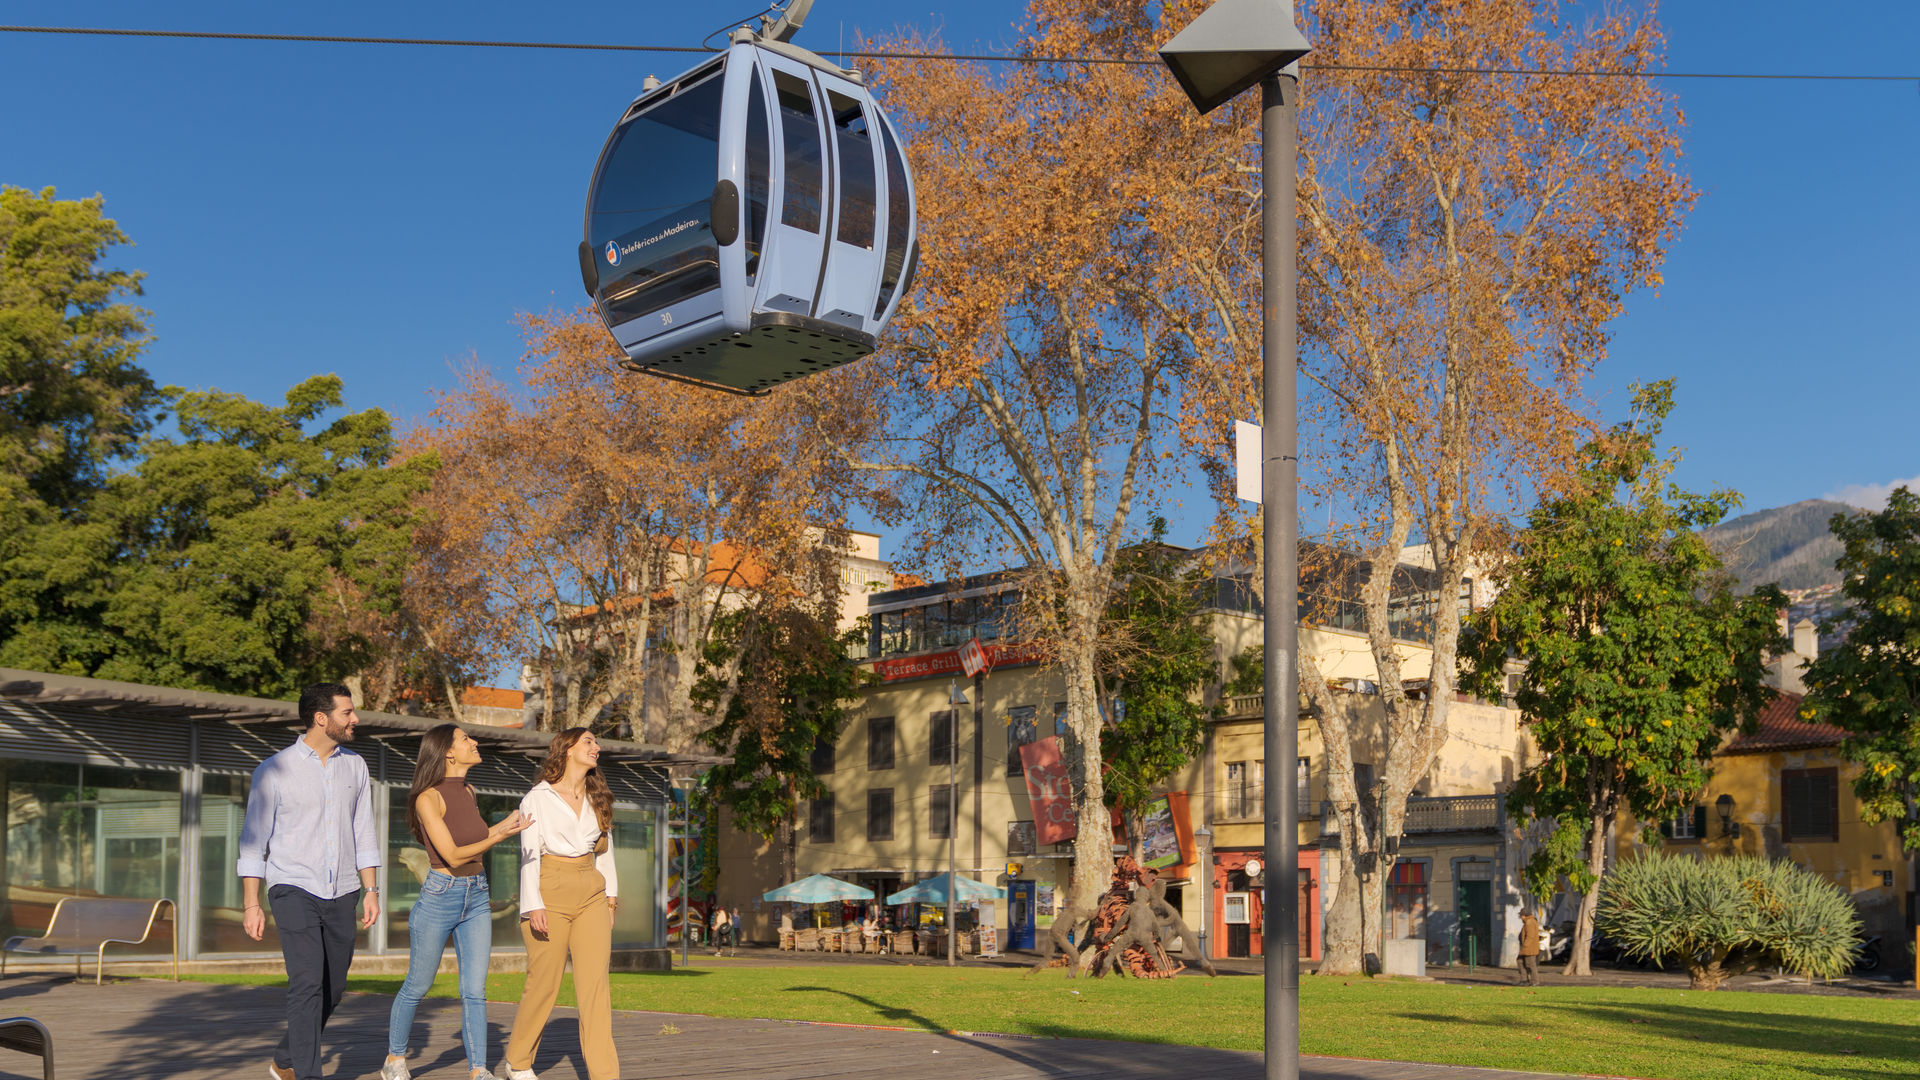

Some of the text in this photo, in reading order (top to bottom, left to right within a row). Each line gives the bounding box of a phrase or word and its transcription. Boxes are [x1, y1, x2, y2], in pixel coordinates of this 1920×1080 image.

[660, 312, 672, 326] 30
[887, 662, 929, 676] Terrace
[931, 655, 960, 670] Grill
